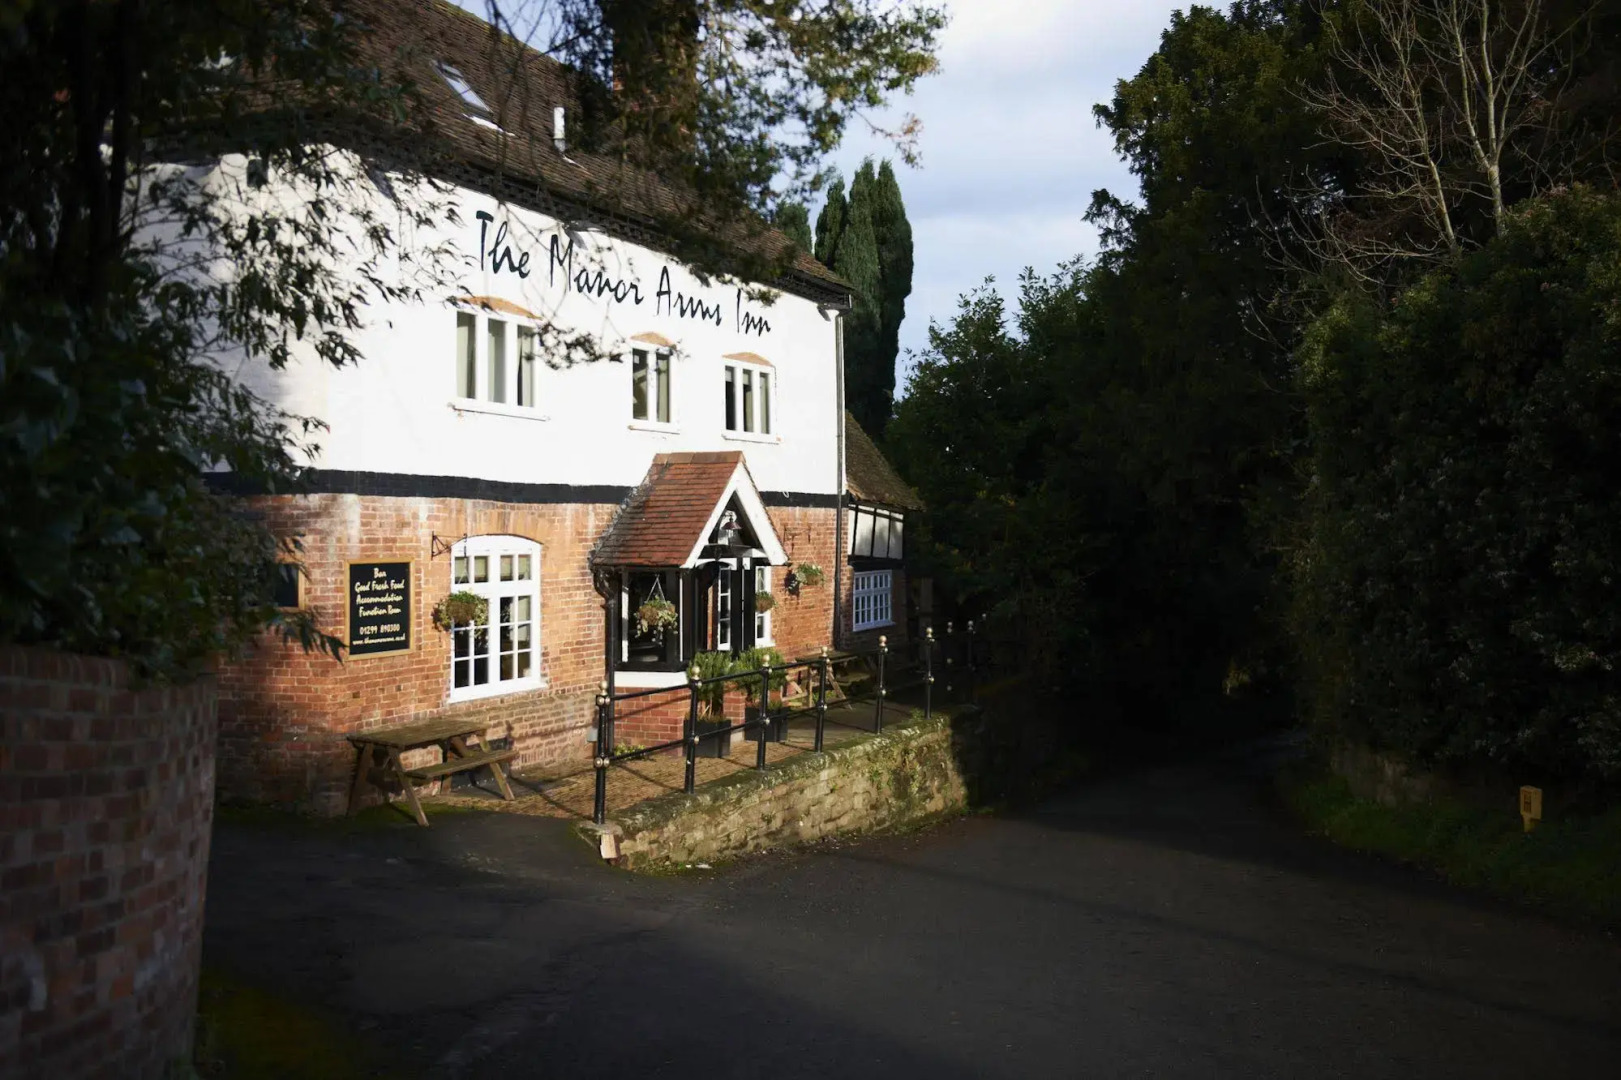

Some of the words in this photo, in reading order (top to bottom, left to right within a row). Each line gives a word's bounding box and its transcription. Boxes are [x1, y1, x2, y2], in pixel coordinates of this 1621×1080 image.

[476, 210, 531, 279] The
[550, 234, 644, 305] Manor
[656, 265, 722, 327] Arms
[737, 288, 772, 337] Inn
[355, 582, 370, 593] Good
[371, 580, 389, 591] Fresh
[390, 579, 405, 590] Food
[359, 606, 387, 617] Function
[388, 605, 401, 614] Room
[360, 625, 378, 635] 01299
